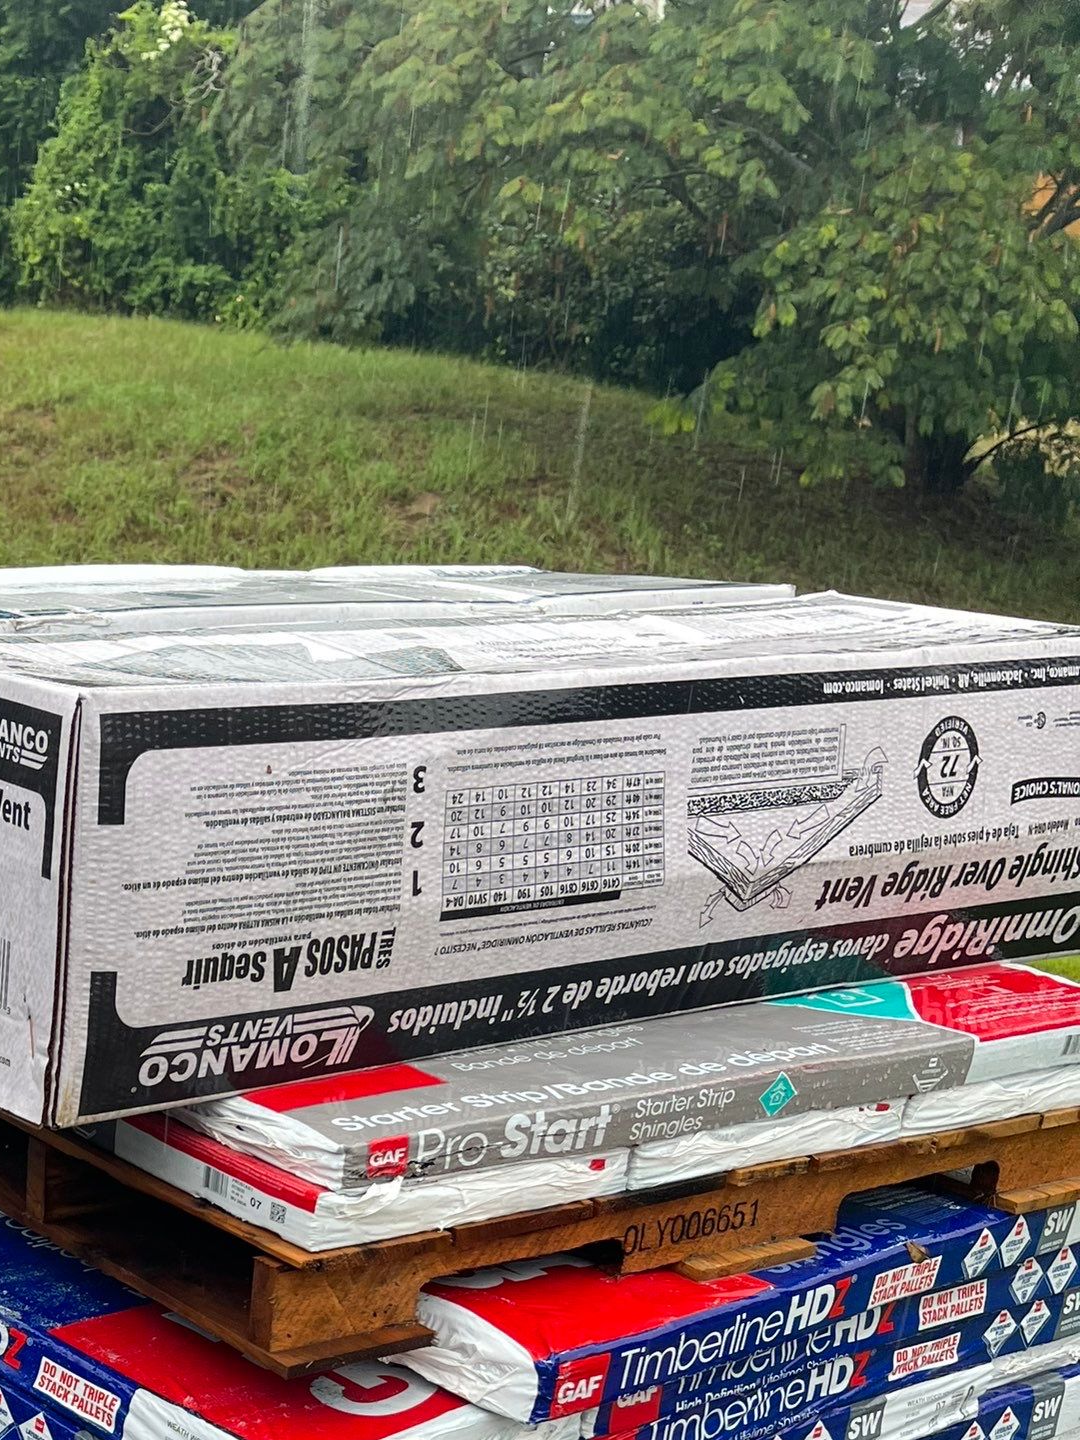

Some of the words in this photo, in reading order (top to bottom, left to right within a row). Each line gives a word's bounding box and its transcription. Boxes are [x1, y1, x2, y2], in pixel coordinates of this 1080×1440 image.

[823, 679, 884, 694] lomanco.com
[893, 678, 920, 692] States
[412, 766, 427, 794] 3
[940, 755, 961, 778] 72
[1015, 781, 1048, 800] CHOICE
[411, 821, 424, 848] 2
[933, 835, 942, 849] la
[943, 831, 967, 847] sobre
[967, 824, 985, 845] pies
[985, 829, 991, 842] 4
[991, 828, 1003, 841] de
[1003, 823, 1020, 840] Teja
[848, 842, 892, 858] cumbrera
[893, 841, 905, 855] de
[411, 869, 423, 897] 1
[881, 860, 953, 903] Ridge
[951, 857, 1006, 891] Over
[815, 875, 878, 912] Vent
[375, 926, 397, 970] TRES
[831, 934, 890, 960] clavos
[894, 906, 1080, 964] OmniRidge
[304, 931, 378, 979] PASOS
[728, 938, 829, 983] espigados
[273, 946, 303, 994] A
[687, 956, 725, 985] con
[541, 985, 561, 1014] 2
[562, 980, 592, 1010] de
[595, 965, 686, 1005] reborde
[205, 1013, 294, 1047] VENTS
[387, 994, 503, 1037] incluidos
[138, 1025, 359, 1087] LOMANCO
[330, 1100, 462, 1133] Starter
[678, 1060, 727, 1076] de
[727, 1042, 839, 1066] départ
[634, 1092, 694, 1120] Starter
[698, 1086, 736, 1108] Strip
[628, 1113, 703, 1141] Shingles
[369, 1146, 407, 1167] GAF
[1044, 1206, 1074, 1237] SW
[556, 1374, 603, 1405] GAF
[620, 1309, 785, 1389] Timberline
[784, 1276, 852, 1336] HDZ
[42, 1361, 57, 1379] DO
[59, 1370, 81, 1391] NOT
[83, 1383, 117, 1411] TRIPLE
[805, 1350, 871, 1402] HDZ
[38, 1375, 69, 1402] STACK
[71, 1394, 114, 1427] PALLETS
